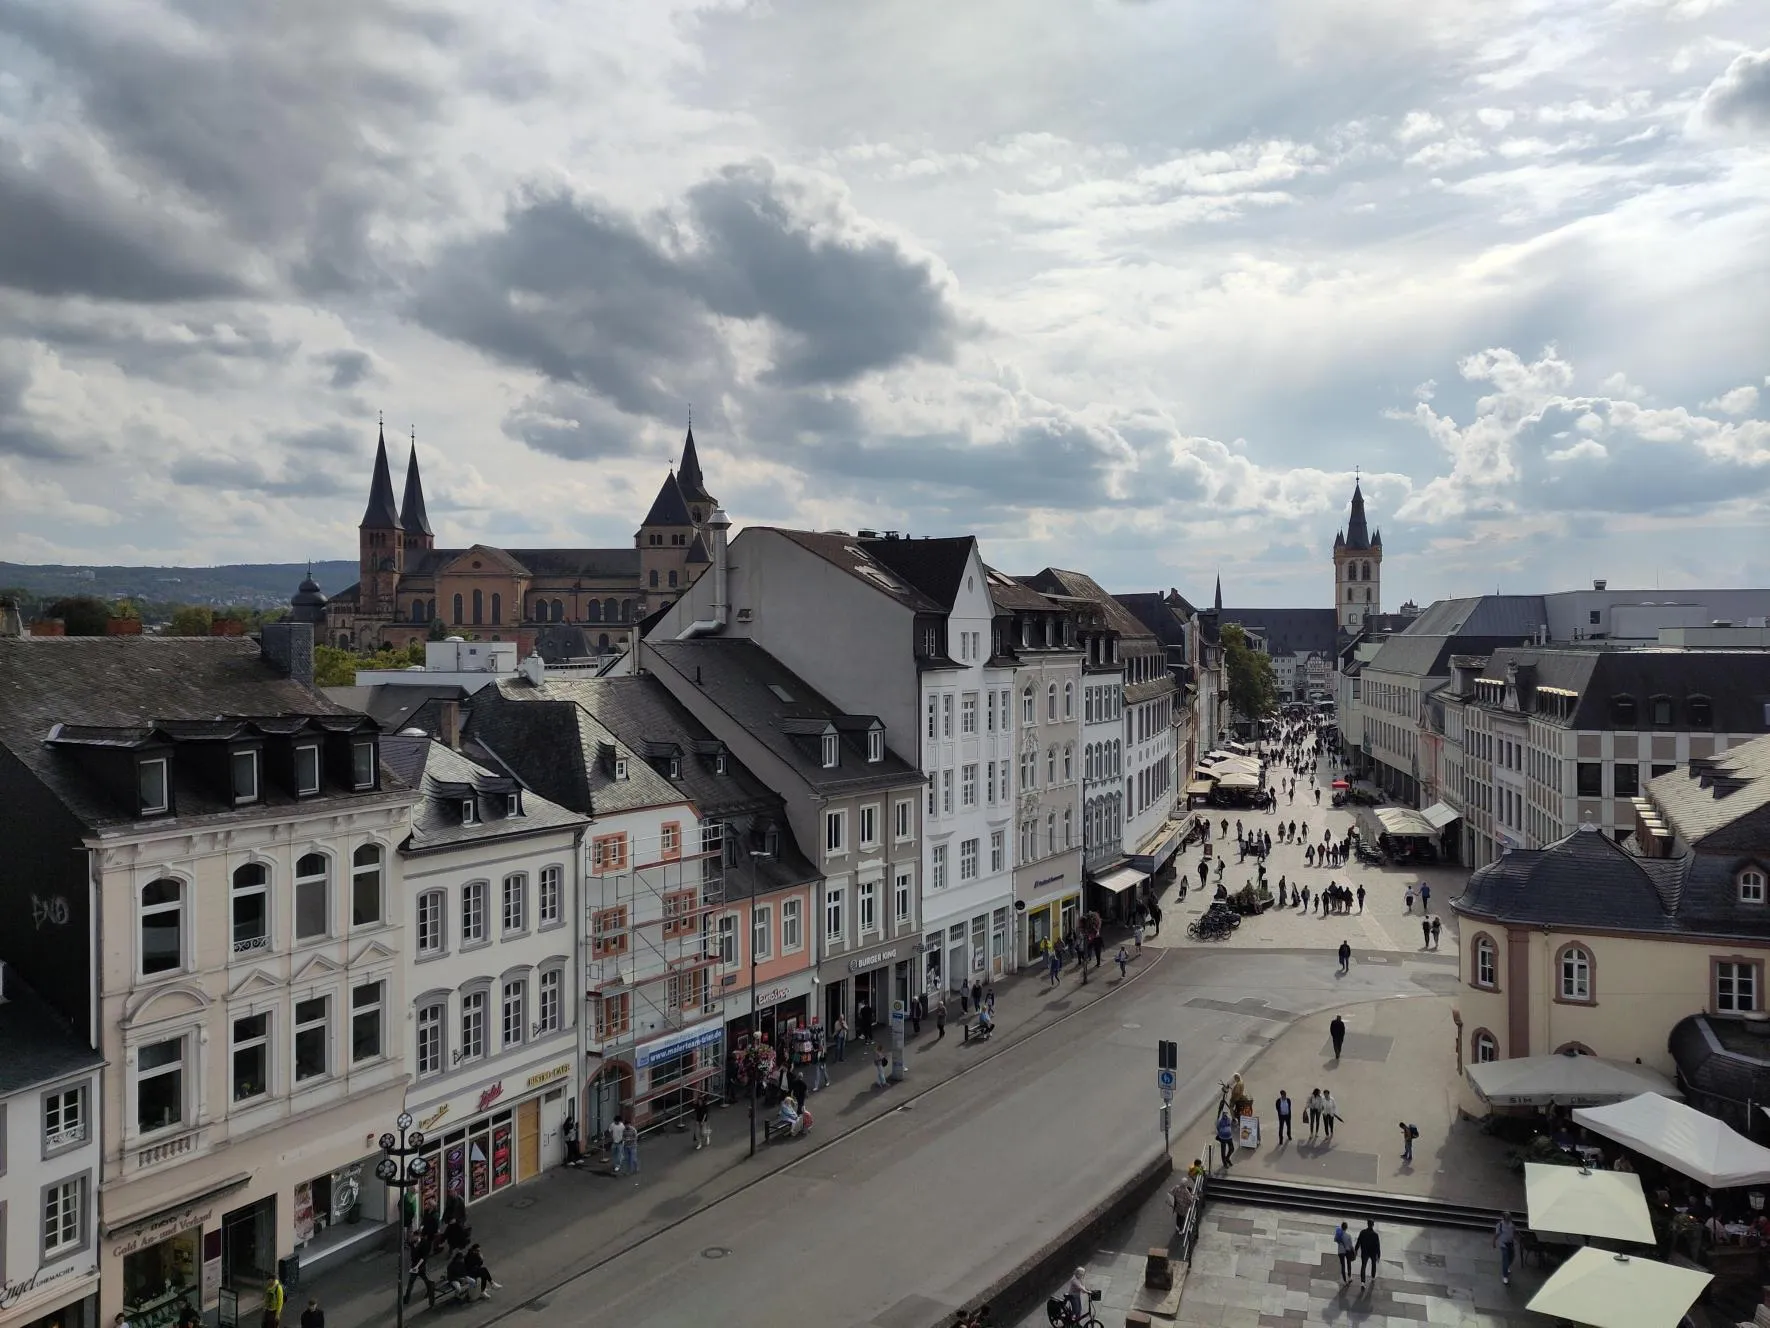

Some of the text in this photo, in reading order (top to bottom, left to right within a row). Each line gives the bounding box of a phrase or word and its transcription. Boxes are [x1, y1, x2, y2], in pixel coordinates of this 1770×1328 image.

[858, 948, 897, 968] BURGER KING
[650, 1030, 722, 1062] www.malerteam-trier.de
[112, 1240, 137, 1258] Gold
[159, 1224, 177, 1239] und
[36, 1266, 75, 1287] UHRMACHER
